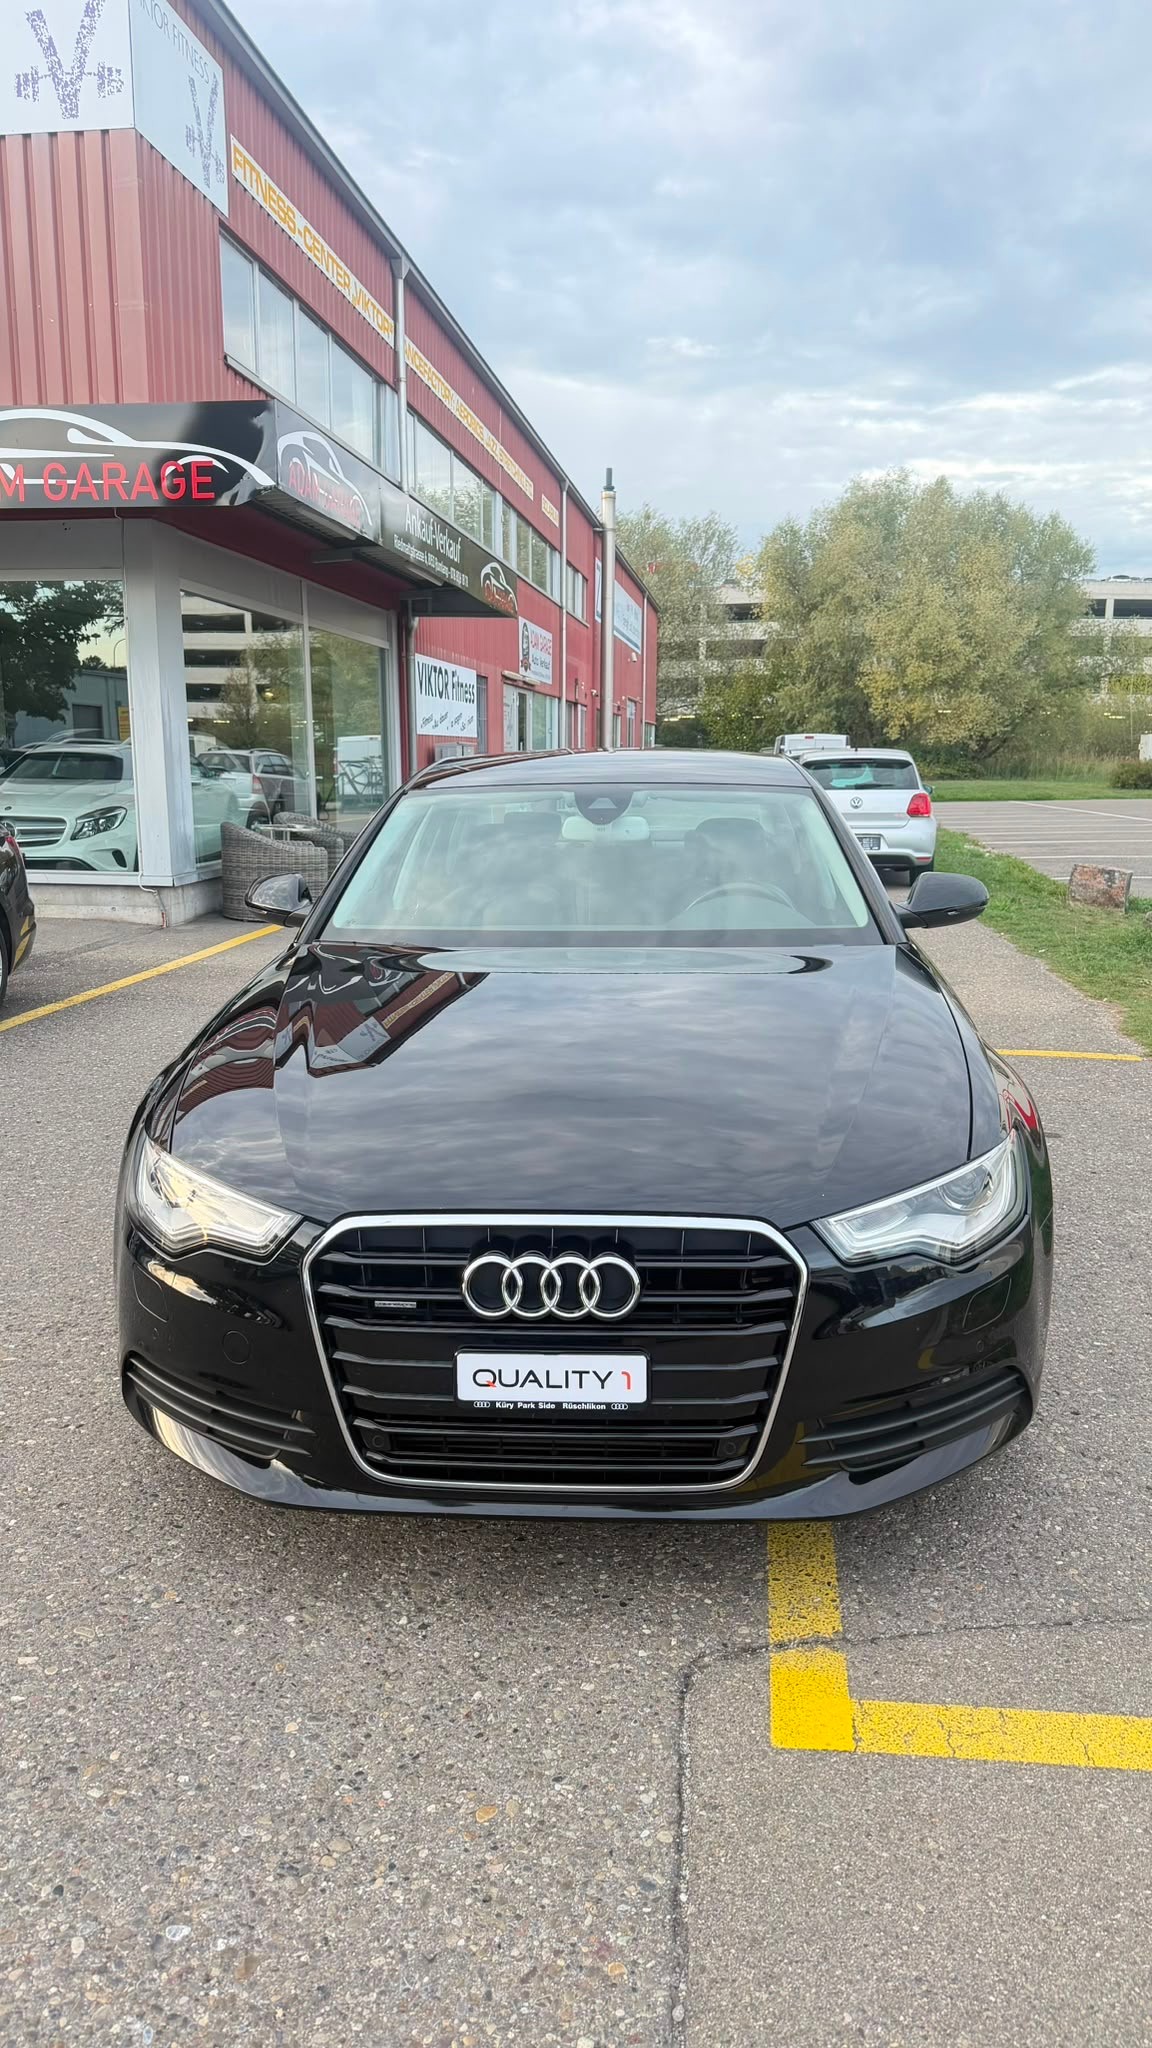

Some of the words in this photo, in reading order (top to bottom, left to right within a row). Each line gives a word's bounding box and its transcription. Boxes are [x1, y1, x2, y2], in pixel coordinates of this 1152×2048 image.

[140, 0, 170, 40] KTOR
[173, 24, 210, 84] FITNESS
[43, 460, 216, 502] GARAGE
[405, 503, 461, 564] Ankauf-Verkauf
[417, 660, 450, 700] VIKTOR
[451, 668, 475, 704] Fitness
[472, 1368, 613, 1389] QUALITY
[621, 1371, 631, 1390] 1
[495, 1401, 514, 1410] Küry
[562, 1402, 606, 1410] Rüschlikon
